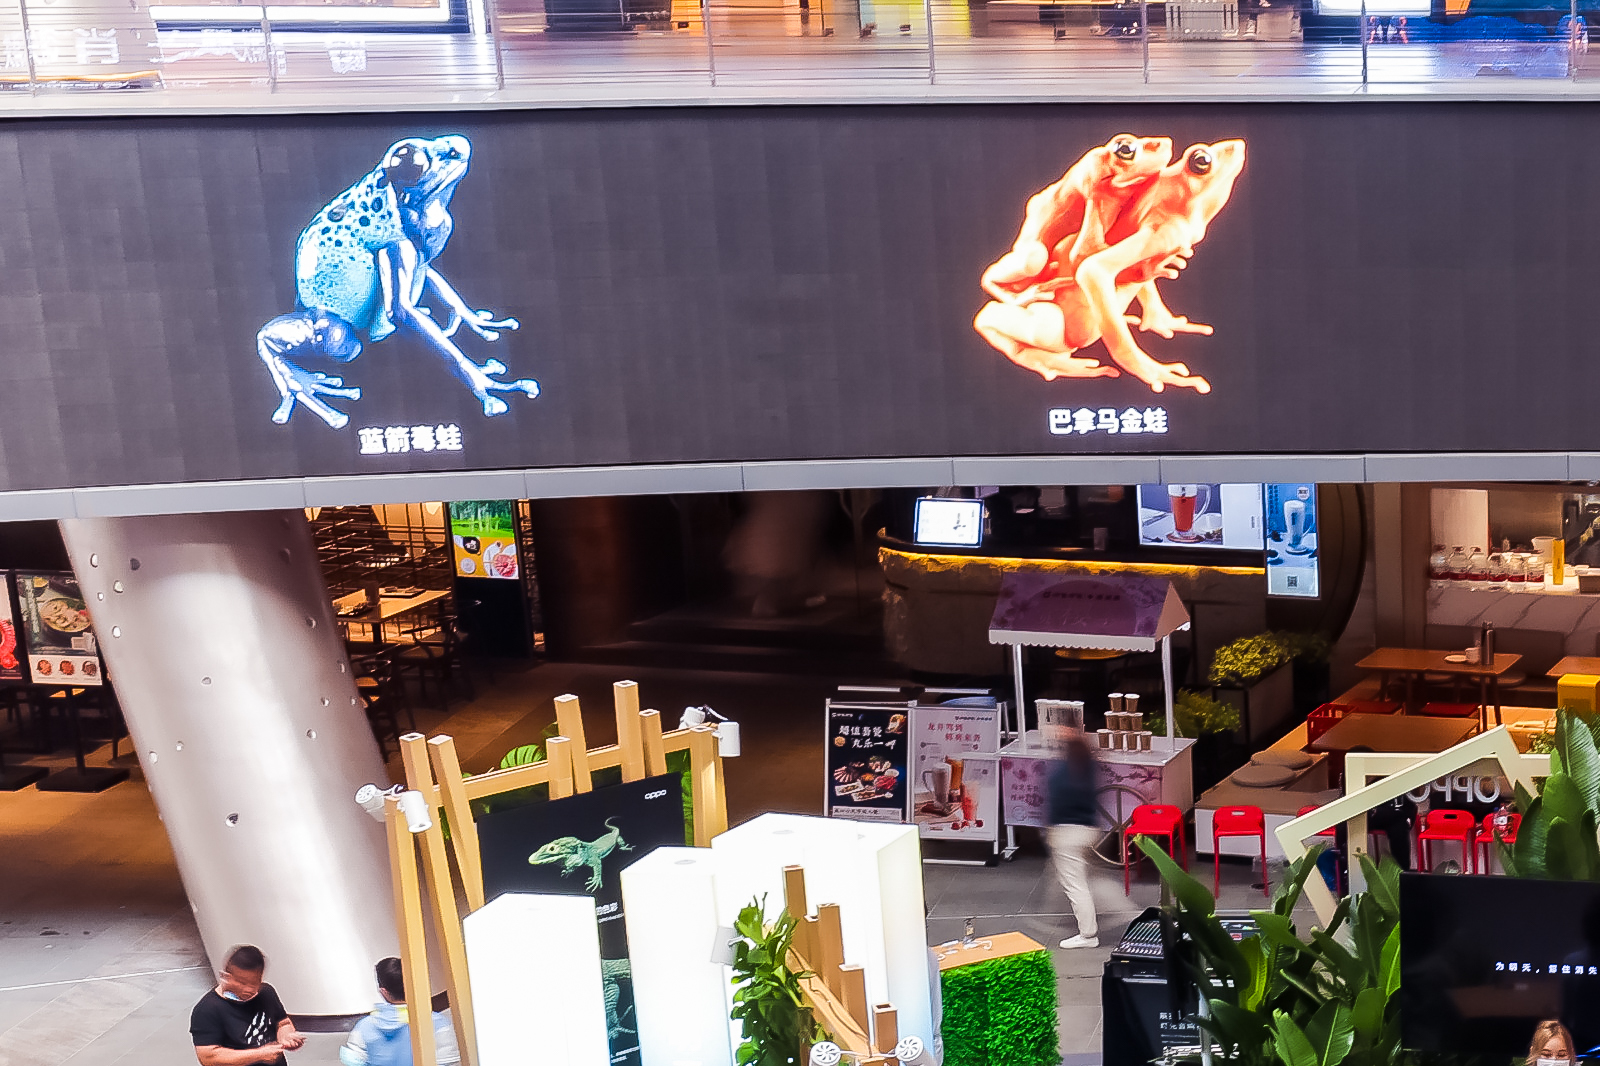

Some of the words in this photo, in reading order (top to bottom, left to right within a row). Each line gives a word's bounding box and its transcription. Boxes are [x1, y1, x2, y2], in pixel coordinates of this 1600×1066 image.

[1049, 406, 1169, 435] 巴拿马金蛙
